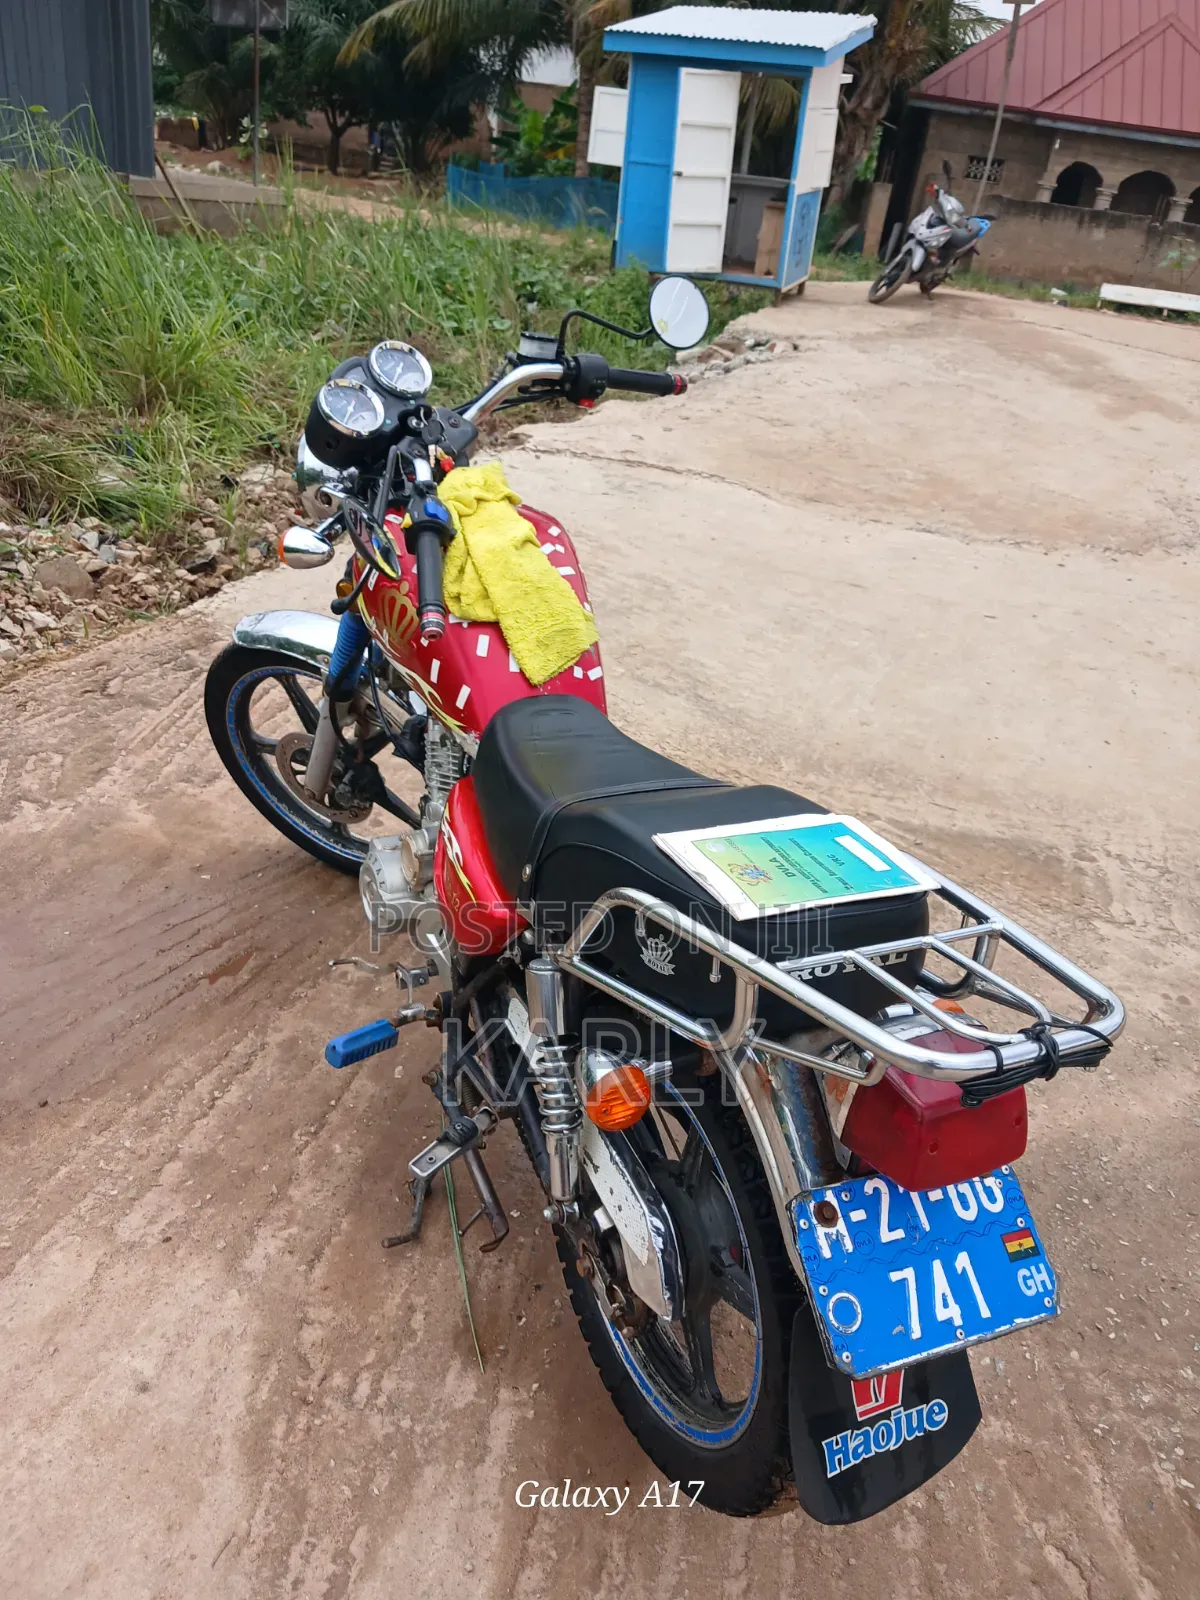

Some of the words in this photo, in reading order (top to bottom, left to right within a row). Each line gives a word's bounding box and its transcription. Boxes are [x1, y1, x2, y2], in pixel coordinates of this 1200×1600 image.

[769, 857, 796, 877] DVLA
[856, 1238, 873, 1248] DVLA
[889, 1251, 992, 1340] 741
[1016, 1263, 1053, 1297] GH
[821, 1398, 949, 1478] Haojue
